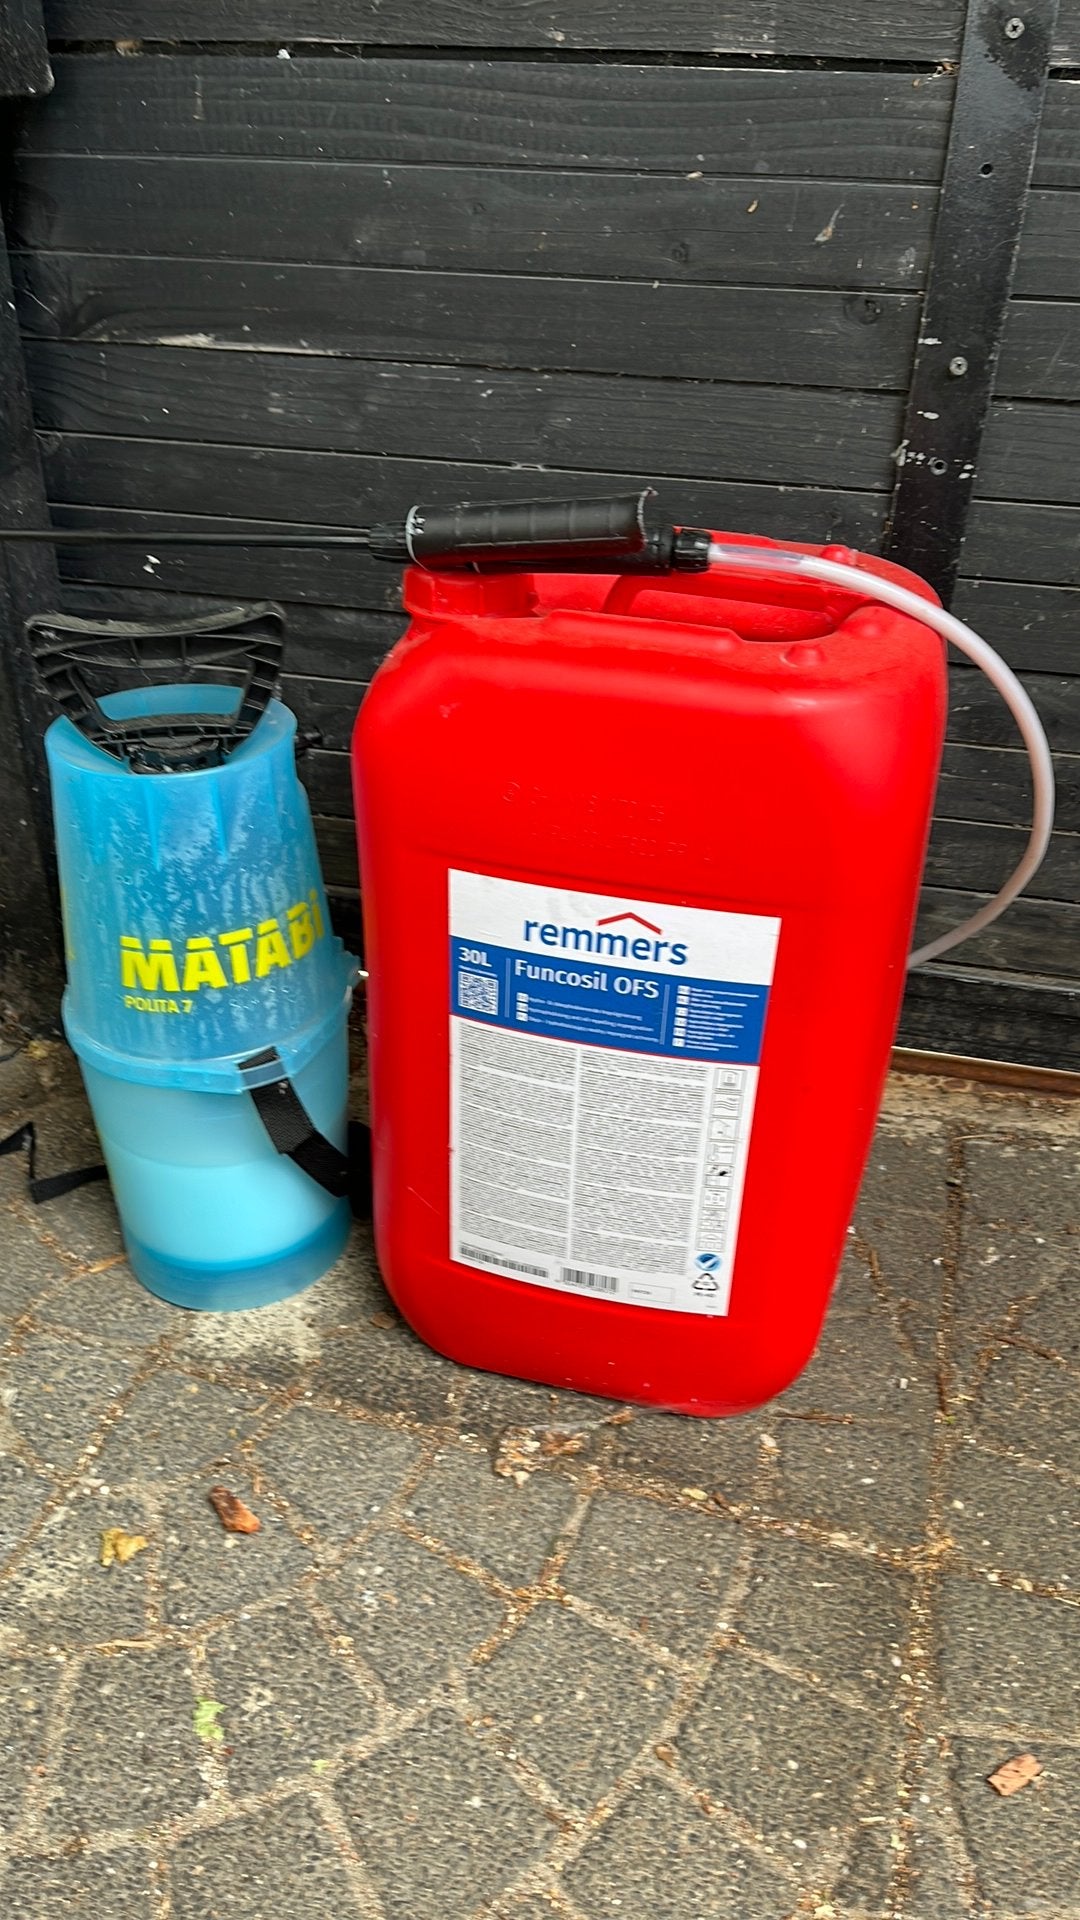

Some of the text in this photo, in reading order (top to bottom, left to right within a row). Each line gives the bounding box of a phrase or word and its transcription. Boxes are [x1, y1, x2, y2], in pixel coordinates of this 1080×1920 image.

[523, 919, 688, 965] remmers
[458, 947, 492, 967] 30L
[515, 960, 609, 992] Funcosil
[612, 975, 660, 999] OFS
[124, 995, 193, 1014] POLITA 7
